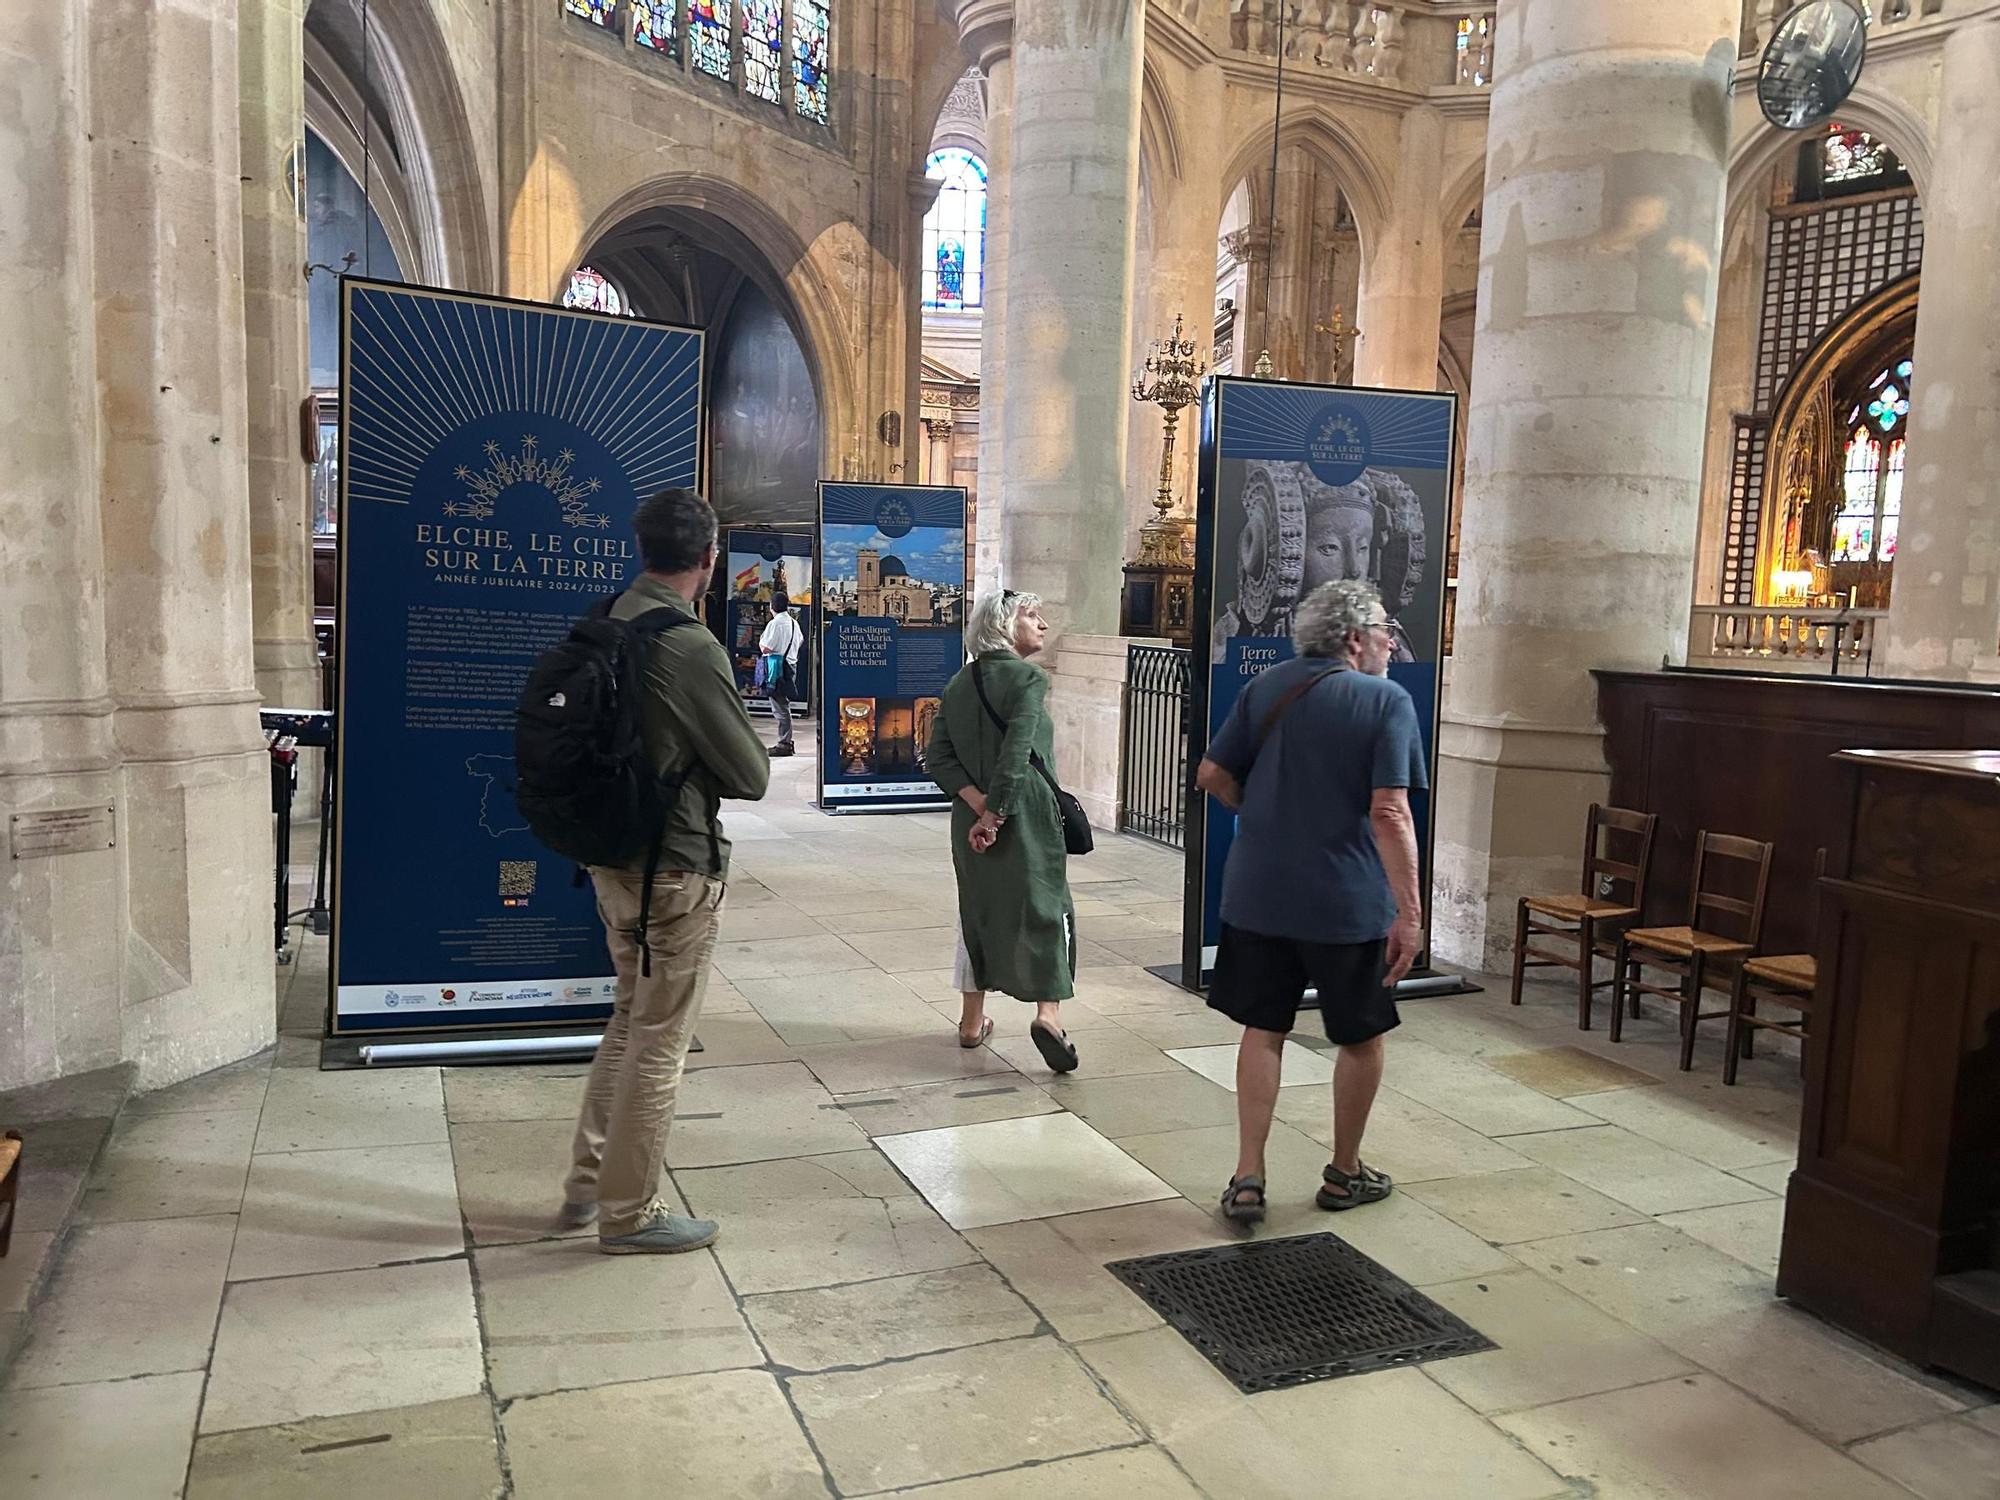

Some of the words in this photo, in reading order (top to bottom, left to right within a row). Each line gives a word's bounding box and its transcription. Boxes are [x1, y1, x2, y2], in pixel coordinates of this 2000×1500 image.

[416, 524, 513, 551] ELCHE,
[530, 533, 562, 552] LE
[573, 537, 633, 559] CIEL
[425, 549, 480, 570] SUR
[493, 553, 528, 573] LA
[538, 556, 625, 581] TERRE
[434, 573, 478, 585] ANNÉE
[482, 577, 543, 589] JUBILAIRE
[548, 581, 616, 594] 2024/2025
[839, 625, 850, 634] La
[852, 625, 891, 636] Basilique
[839, 633, 864, 642] Santa
[839, 641, 848, 650] là
[862, 641, 871, 650] le
[872, 641, 887, 650] ciel
[839, 650, 848, 658] et
[850, 650, 858, 658] la
[860, 650, 881, 658] terre
[1239, 645, 1277, 660] Terre
[839, 658, 849, 666] se
[851, 658, 887, 666] touchent
